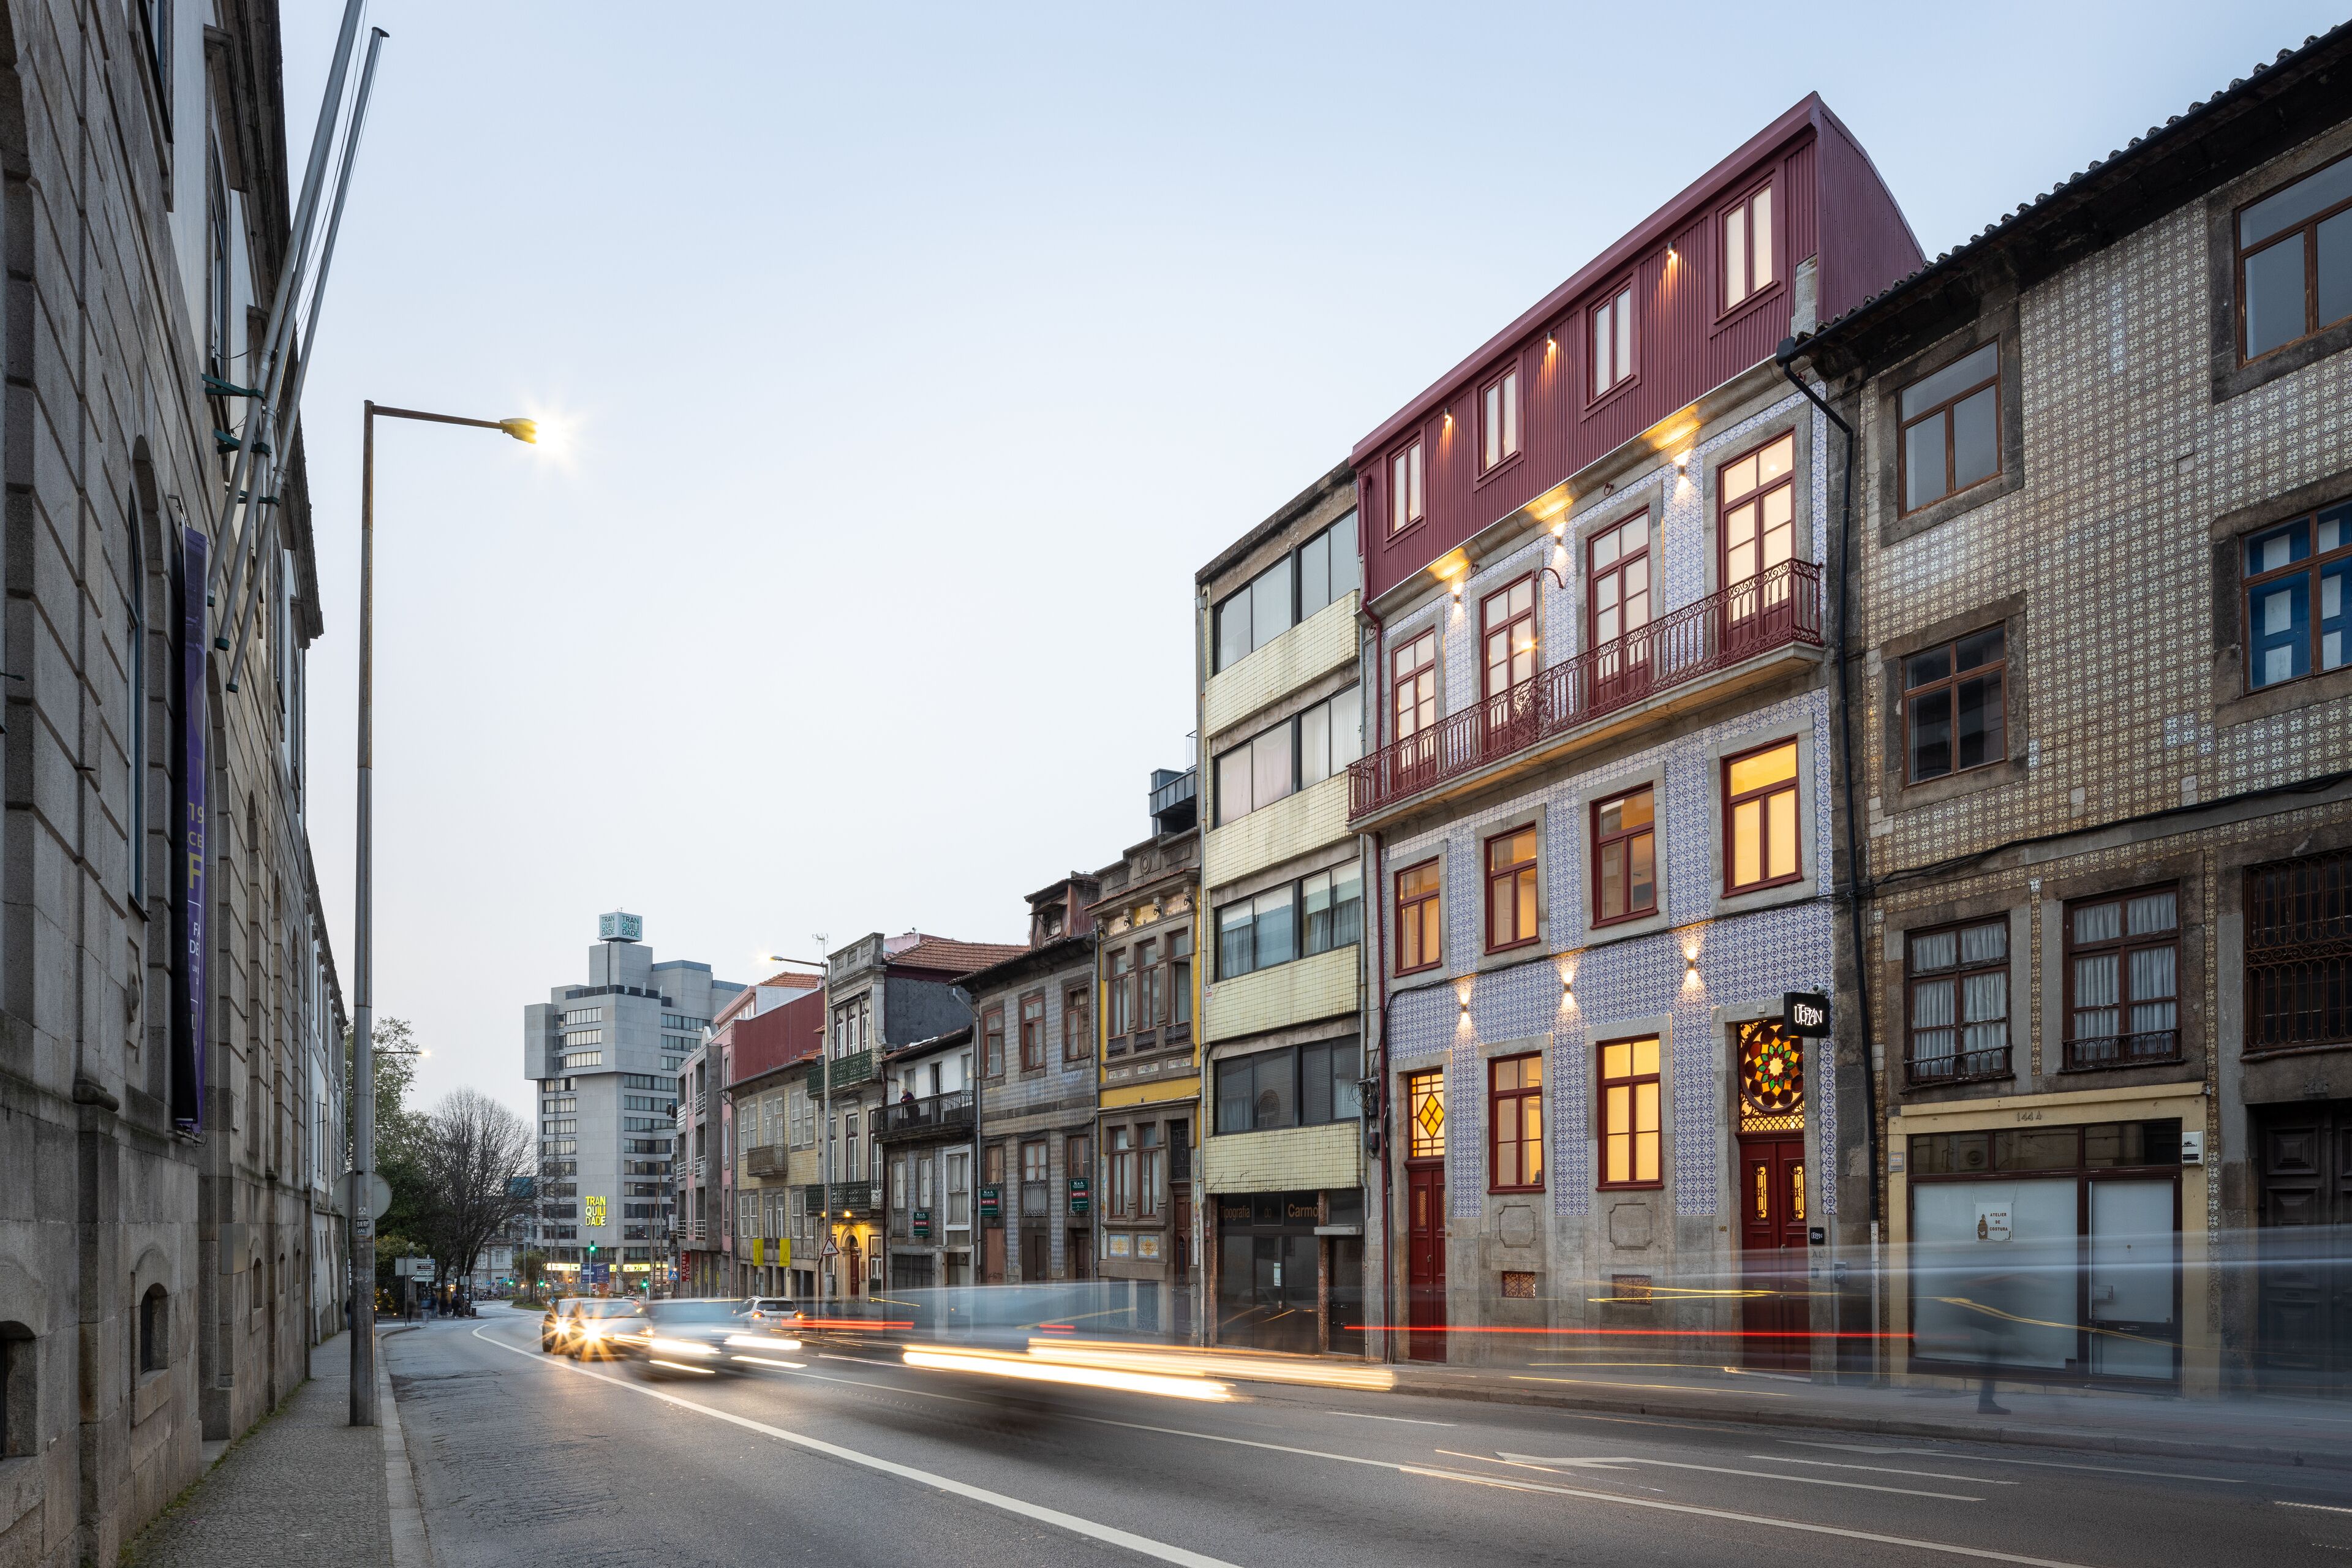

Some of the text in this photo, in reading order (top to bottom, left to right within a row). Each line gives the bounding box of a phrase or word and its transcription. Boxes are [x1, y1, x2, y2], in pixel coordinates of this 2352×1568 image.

[622, 915, 639, 924] TRAN
[622, 922, 639, 931] QUILI
[622, 929, 639, 938] DADE
[2016, 1112, 2034, 1121] 144
[586, 1196, 606, 1206] TRAN
[586, 1206, 606, 1217] QUILI
[1220, 1203, 1318, 1221] Tipografia do Carmo
[586, 1216, 606, 1226] DADE
